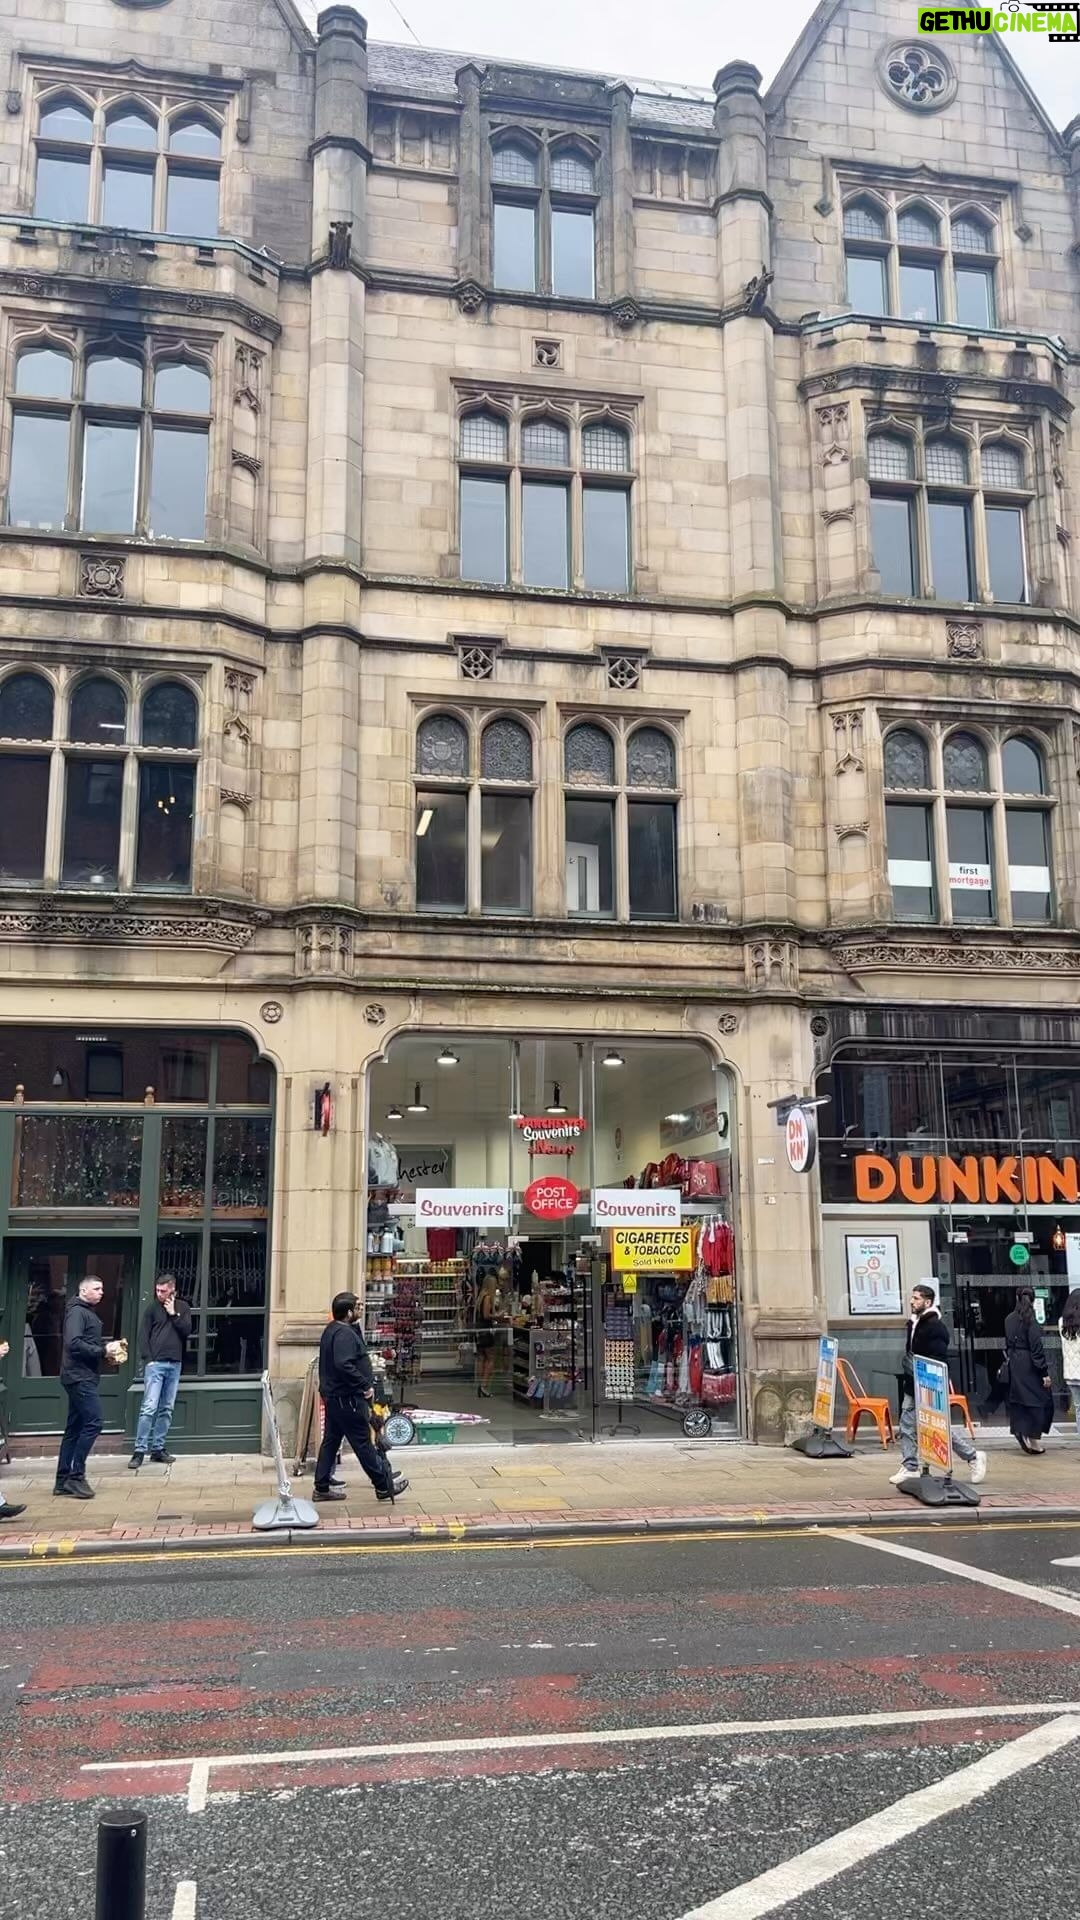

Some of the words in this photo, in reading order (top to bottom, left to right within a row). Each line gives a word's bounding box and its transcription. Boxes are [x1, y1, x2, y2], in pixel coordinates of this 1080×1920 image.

[959, 866, 978, 875] first
[949, 877, 988, 886] mortgage
[523, 1125, 581, 1141] Souvenirs
[788, 1120, 803, 1139] DN
[398, 1159, 446, 1182] hester
[855, 1154, 1078, 1204] DUNKIN
[536, 1187, 567, 1198] POST
[420, 1200, 504, 1217] Souvenirs
[531, 1199, 574, 1210] OFFICE
[596, 1200, 676, 1217] Souvenirs
[616, 1232, 690, 1244] CIGARETTES
[624, 1246, 631, 1256] &
[633, 1245, 681, 1256] TOBACCO
[632, 1259, 652, 1267] Sold
